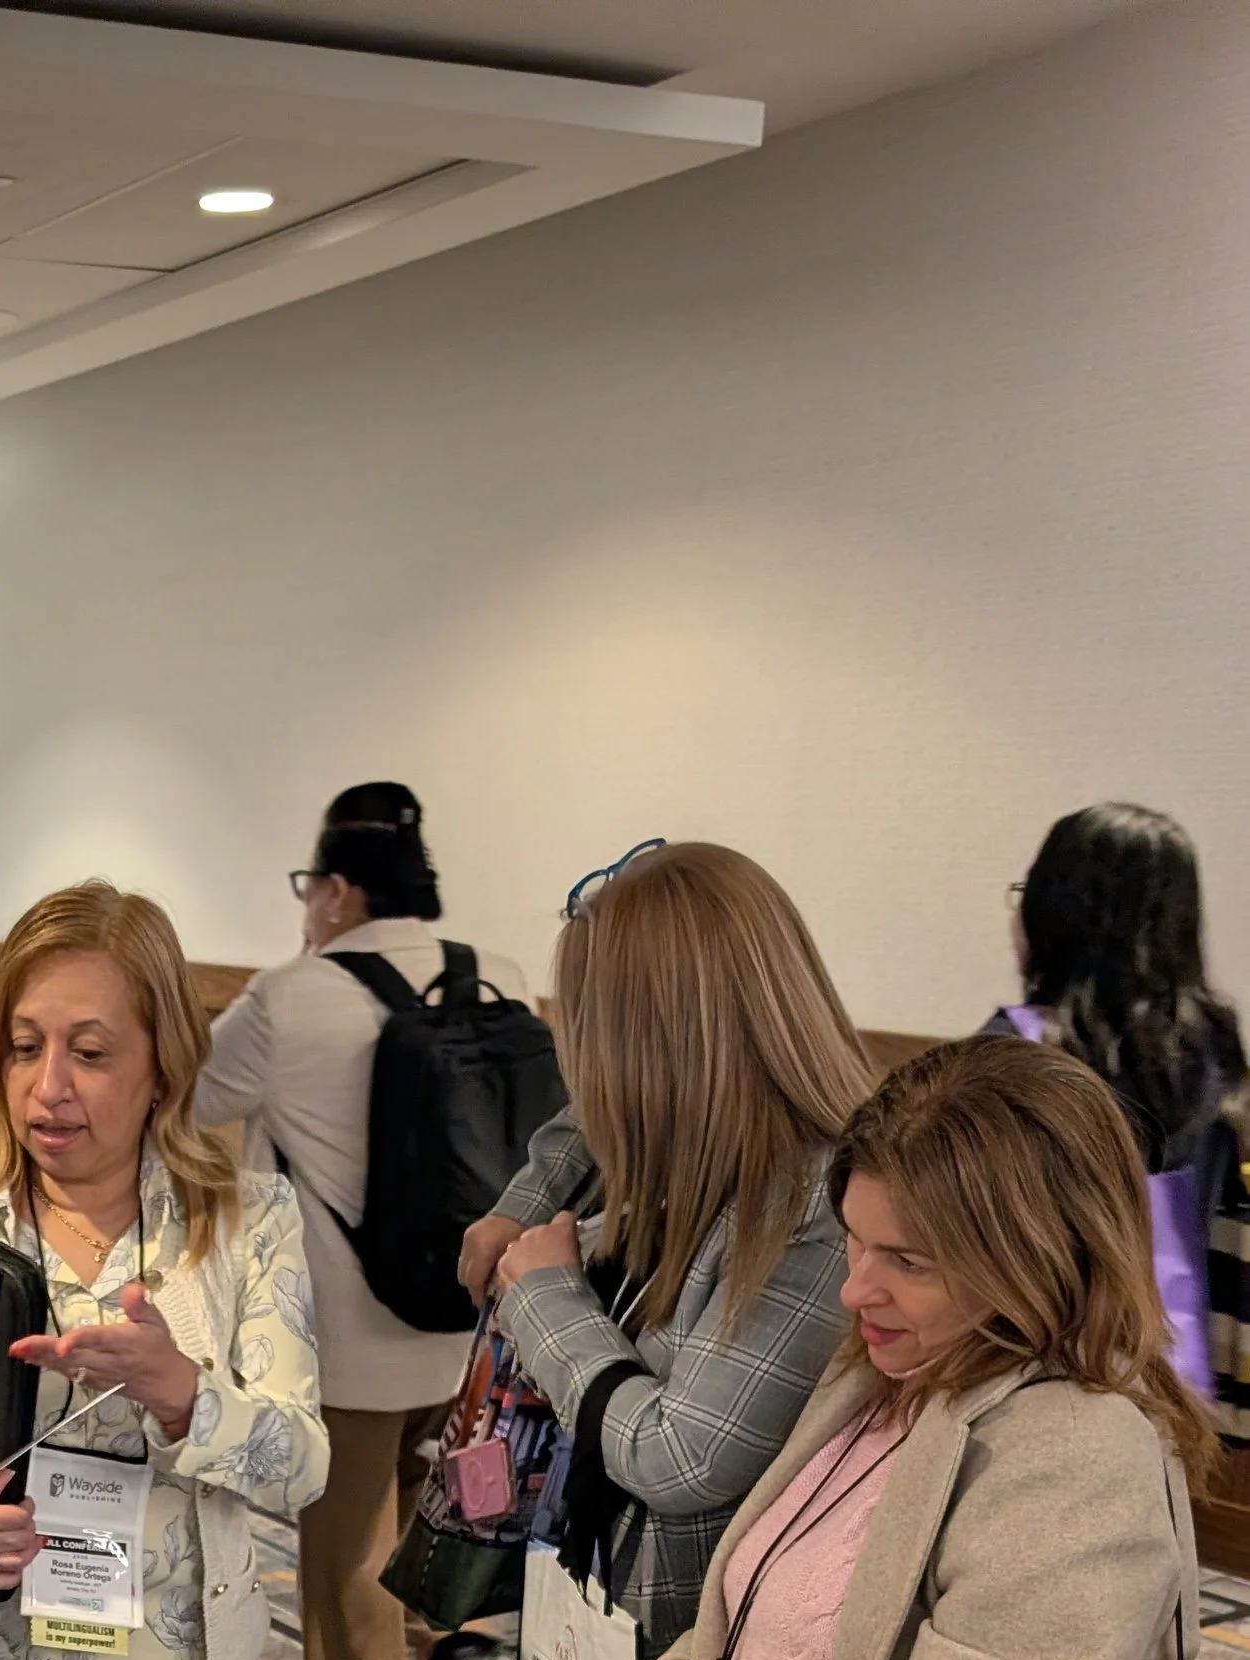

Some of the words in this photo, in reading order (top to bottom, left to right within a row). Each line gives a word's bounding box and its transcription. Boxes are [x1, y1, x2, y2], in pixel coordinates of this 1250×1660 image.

[69, 1477, 123, 1494] Wayside
[52, 1559, 73, 1569] Rosa
[75, 1562, 109, 1575] Eugenia
[50, 1568, 82, 1579] Moreno
[83, 1570, 112, 1583] Ortega
[47, 1620, 115, 1637] MULTILINGUALISM
[46, 1632, 54, 1642] is
[55, 1635, 66, 1644] my
[68, 1636, 116, 1648] superpower!
